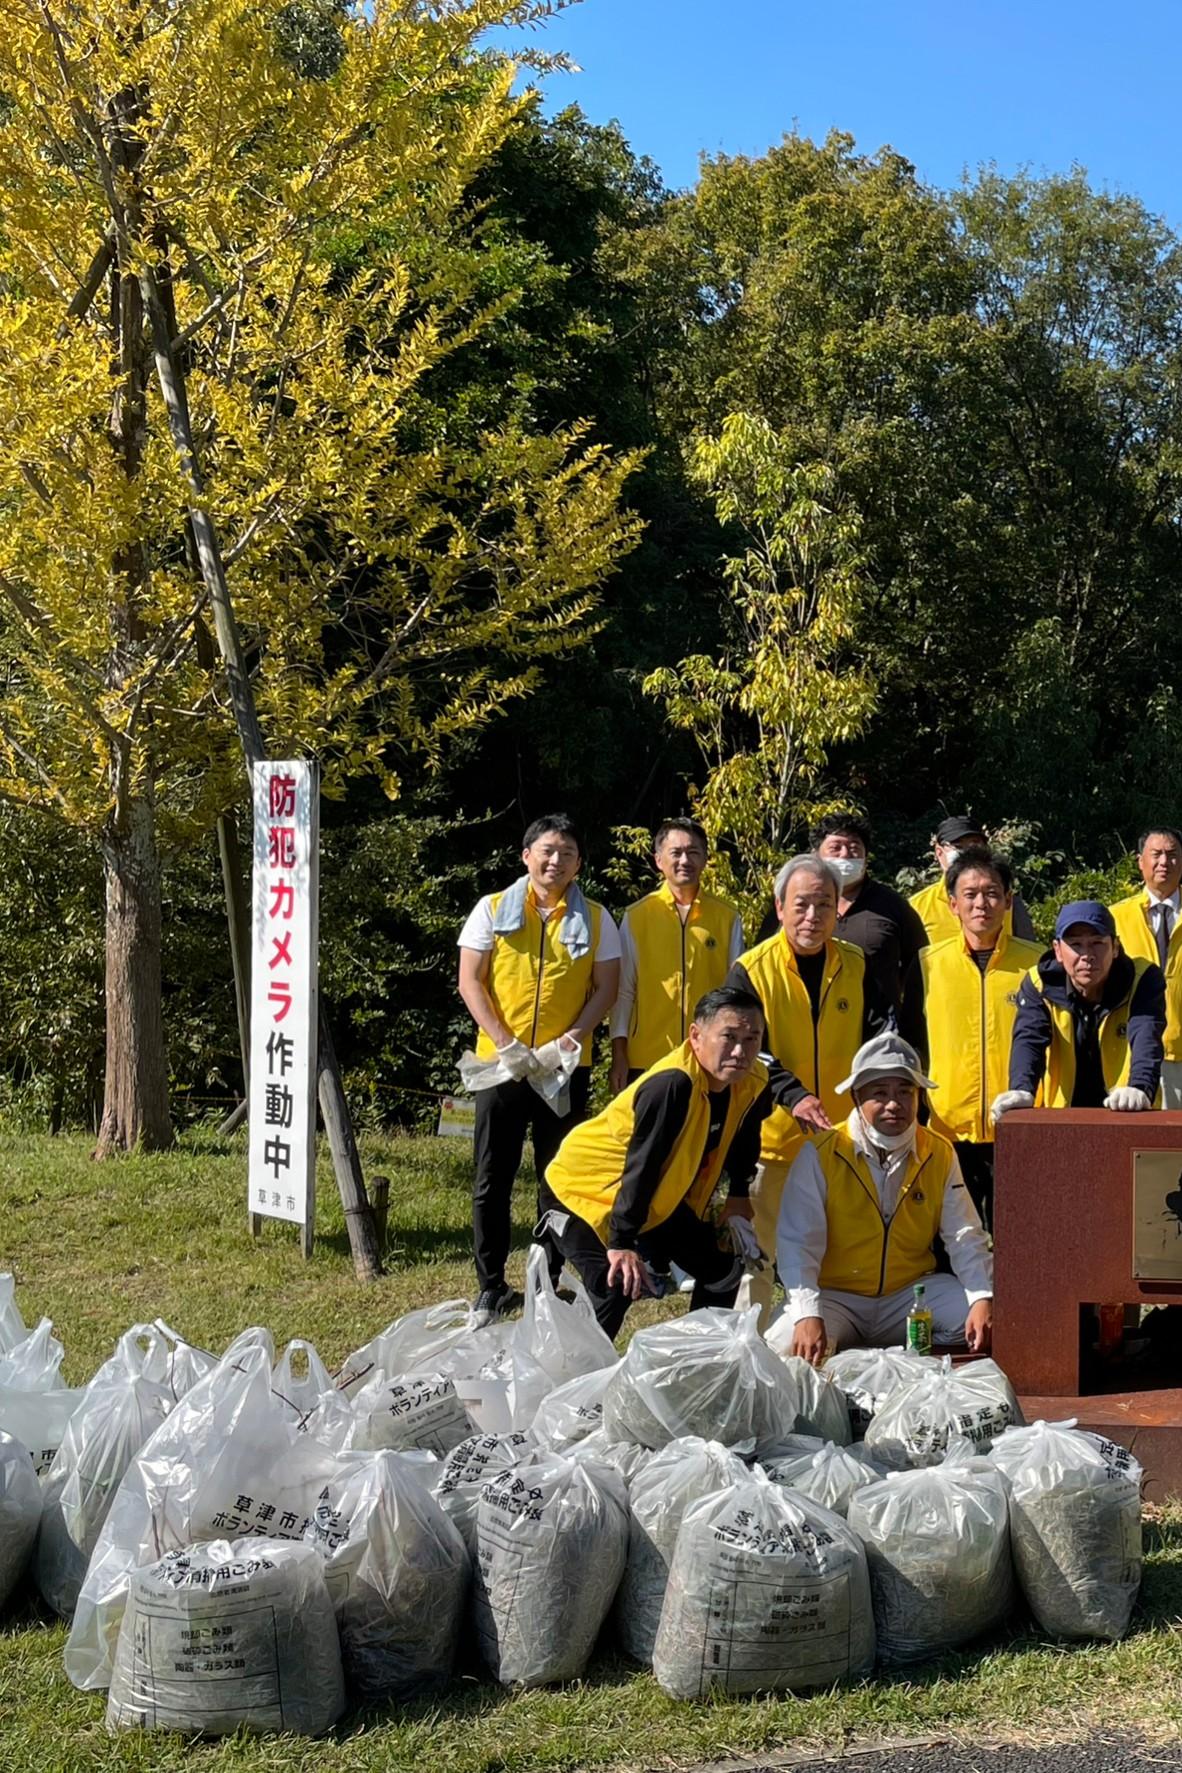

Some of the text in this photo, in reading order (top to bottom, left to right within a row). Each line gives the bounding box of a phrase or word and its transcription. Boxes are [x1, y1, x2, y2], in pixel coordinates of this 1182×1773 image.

[264, 774, 297, 1180] 防犯カメラ作動中
[258, 1188, 296, 1213] 草津市
